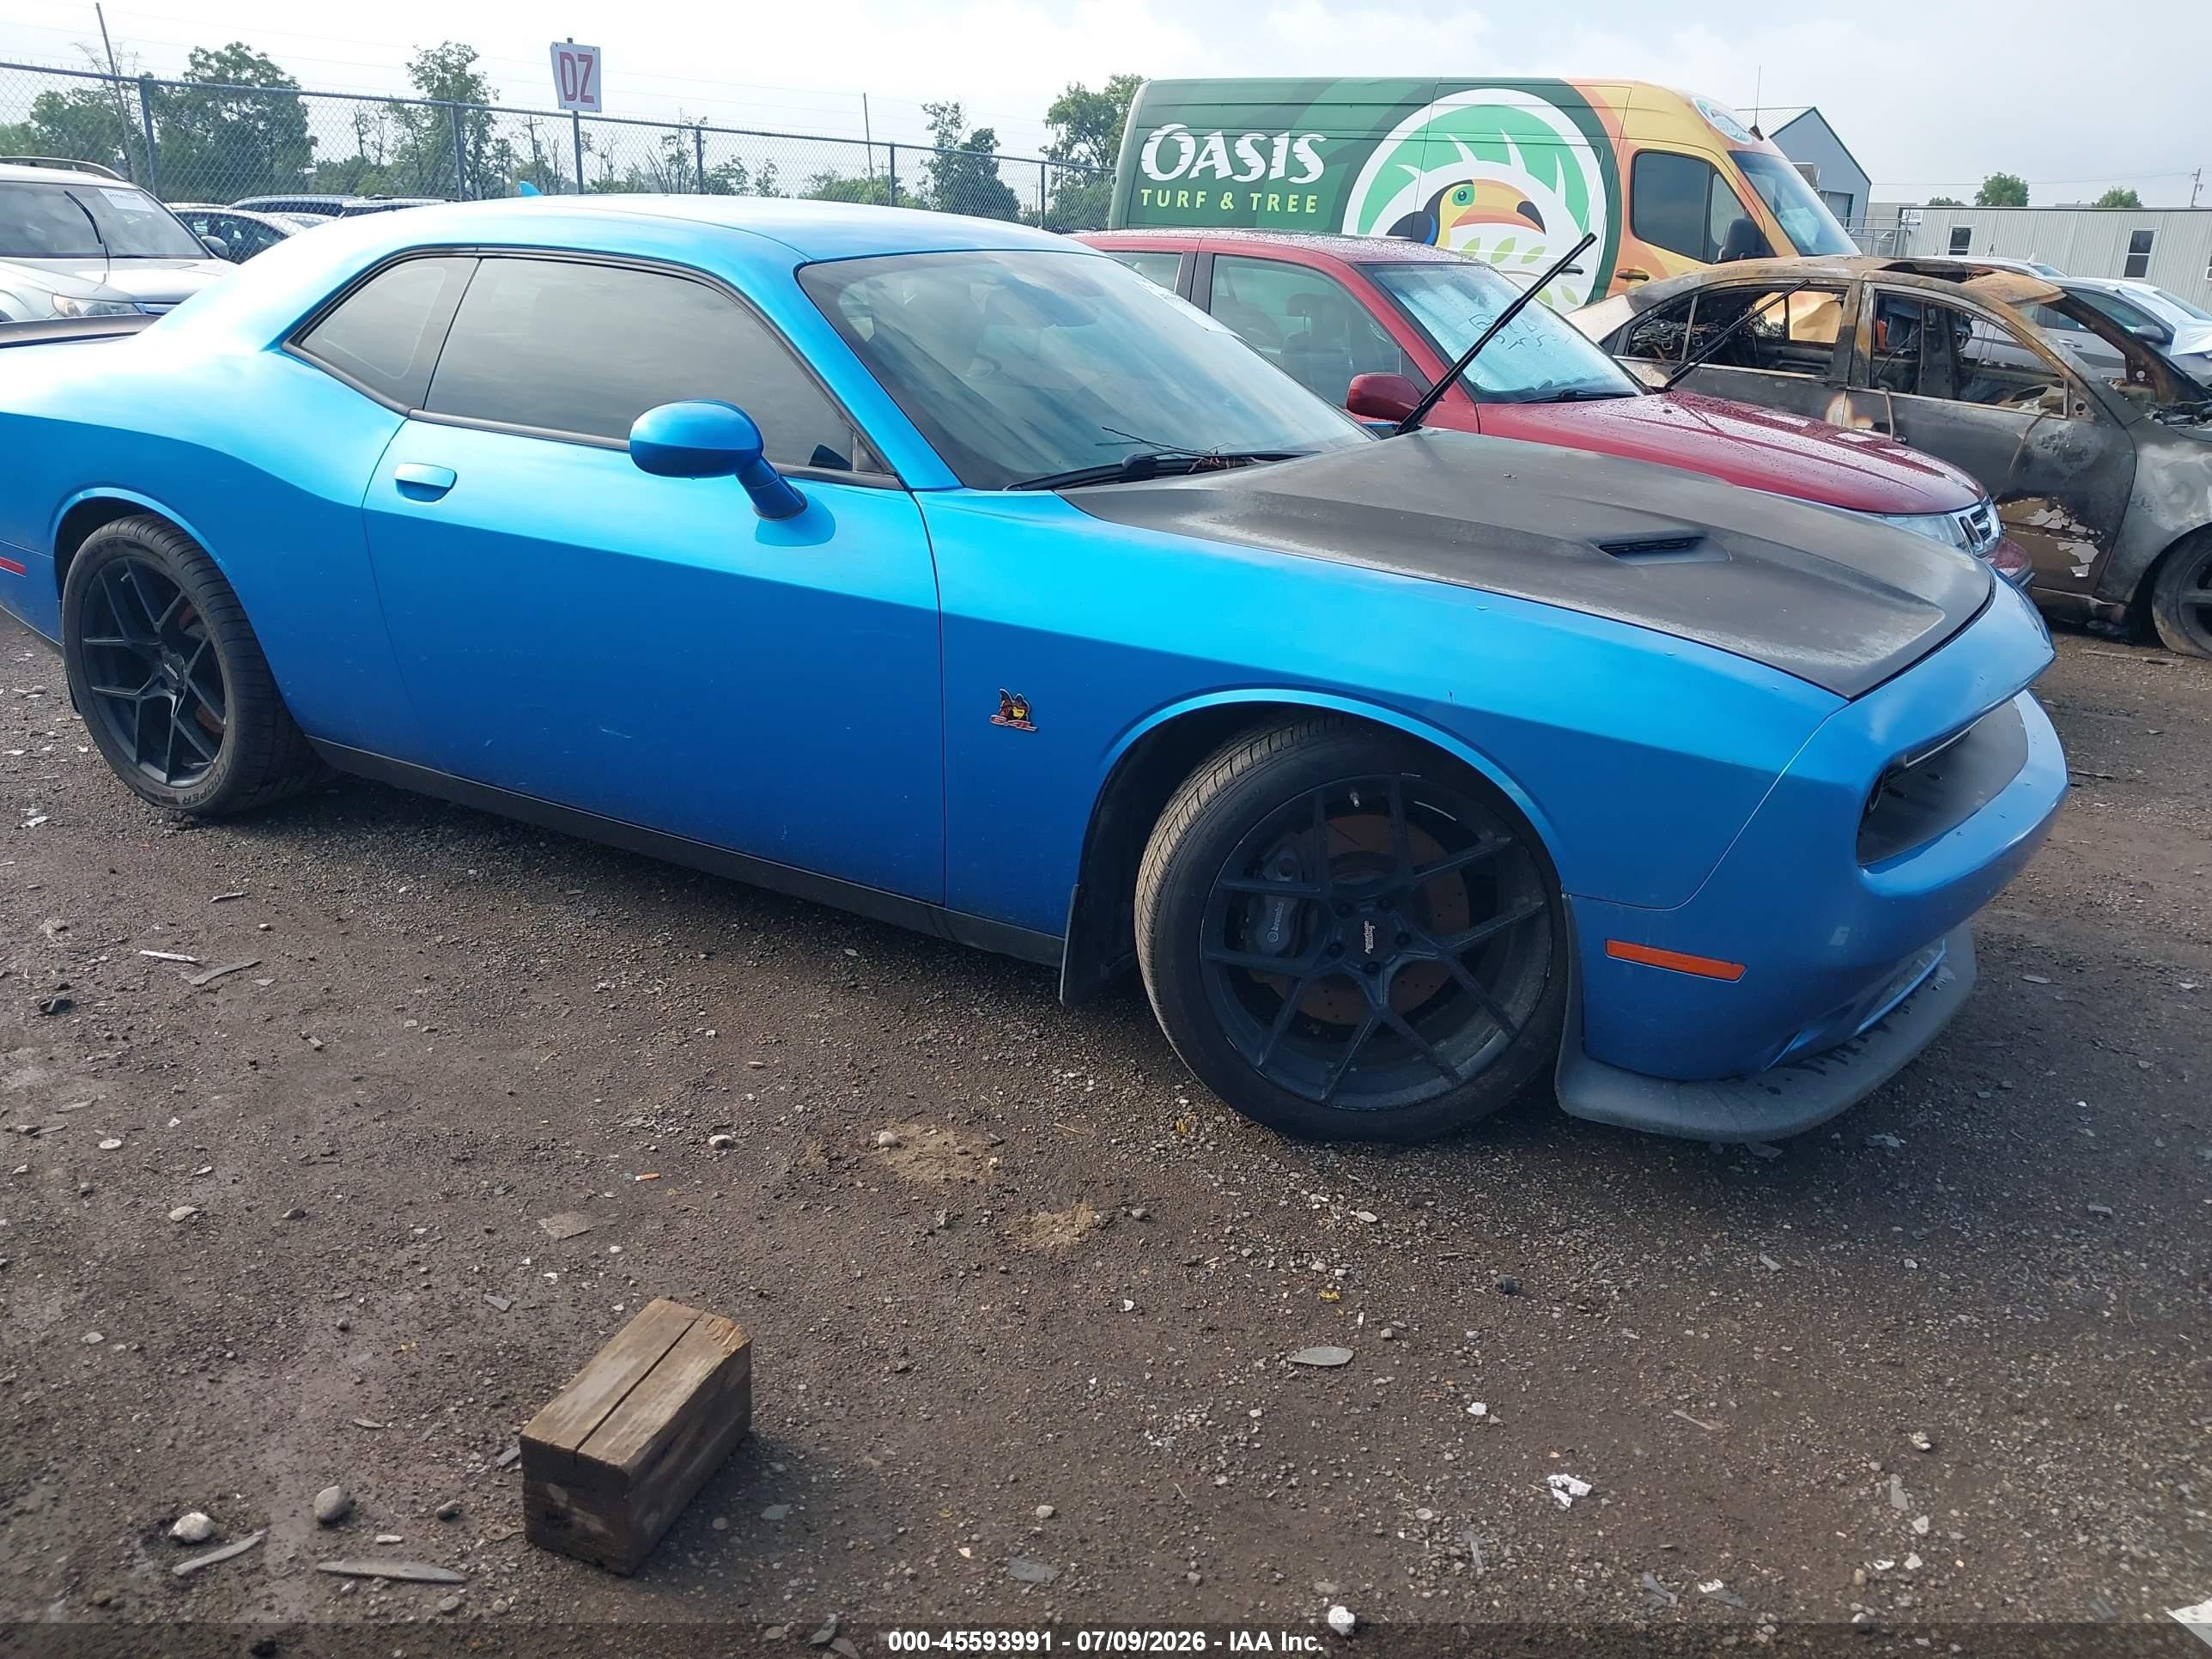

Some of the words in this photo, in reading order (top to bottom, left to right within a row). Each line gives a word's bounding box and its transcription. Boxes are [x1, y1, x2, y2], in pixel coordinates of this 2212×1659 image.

[559, 52, 594, 103] DZ
[1140, 123, 1327, 184] OASIS
[1140, 188, 1206, 210] TURF
[1219, 191, 1235, 210] &
[1250, 191, 1319, 214] TREE
